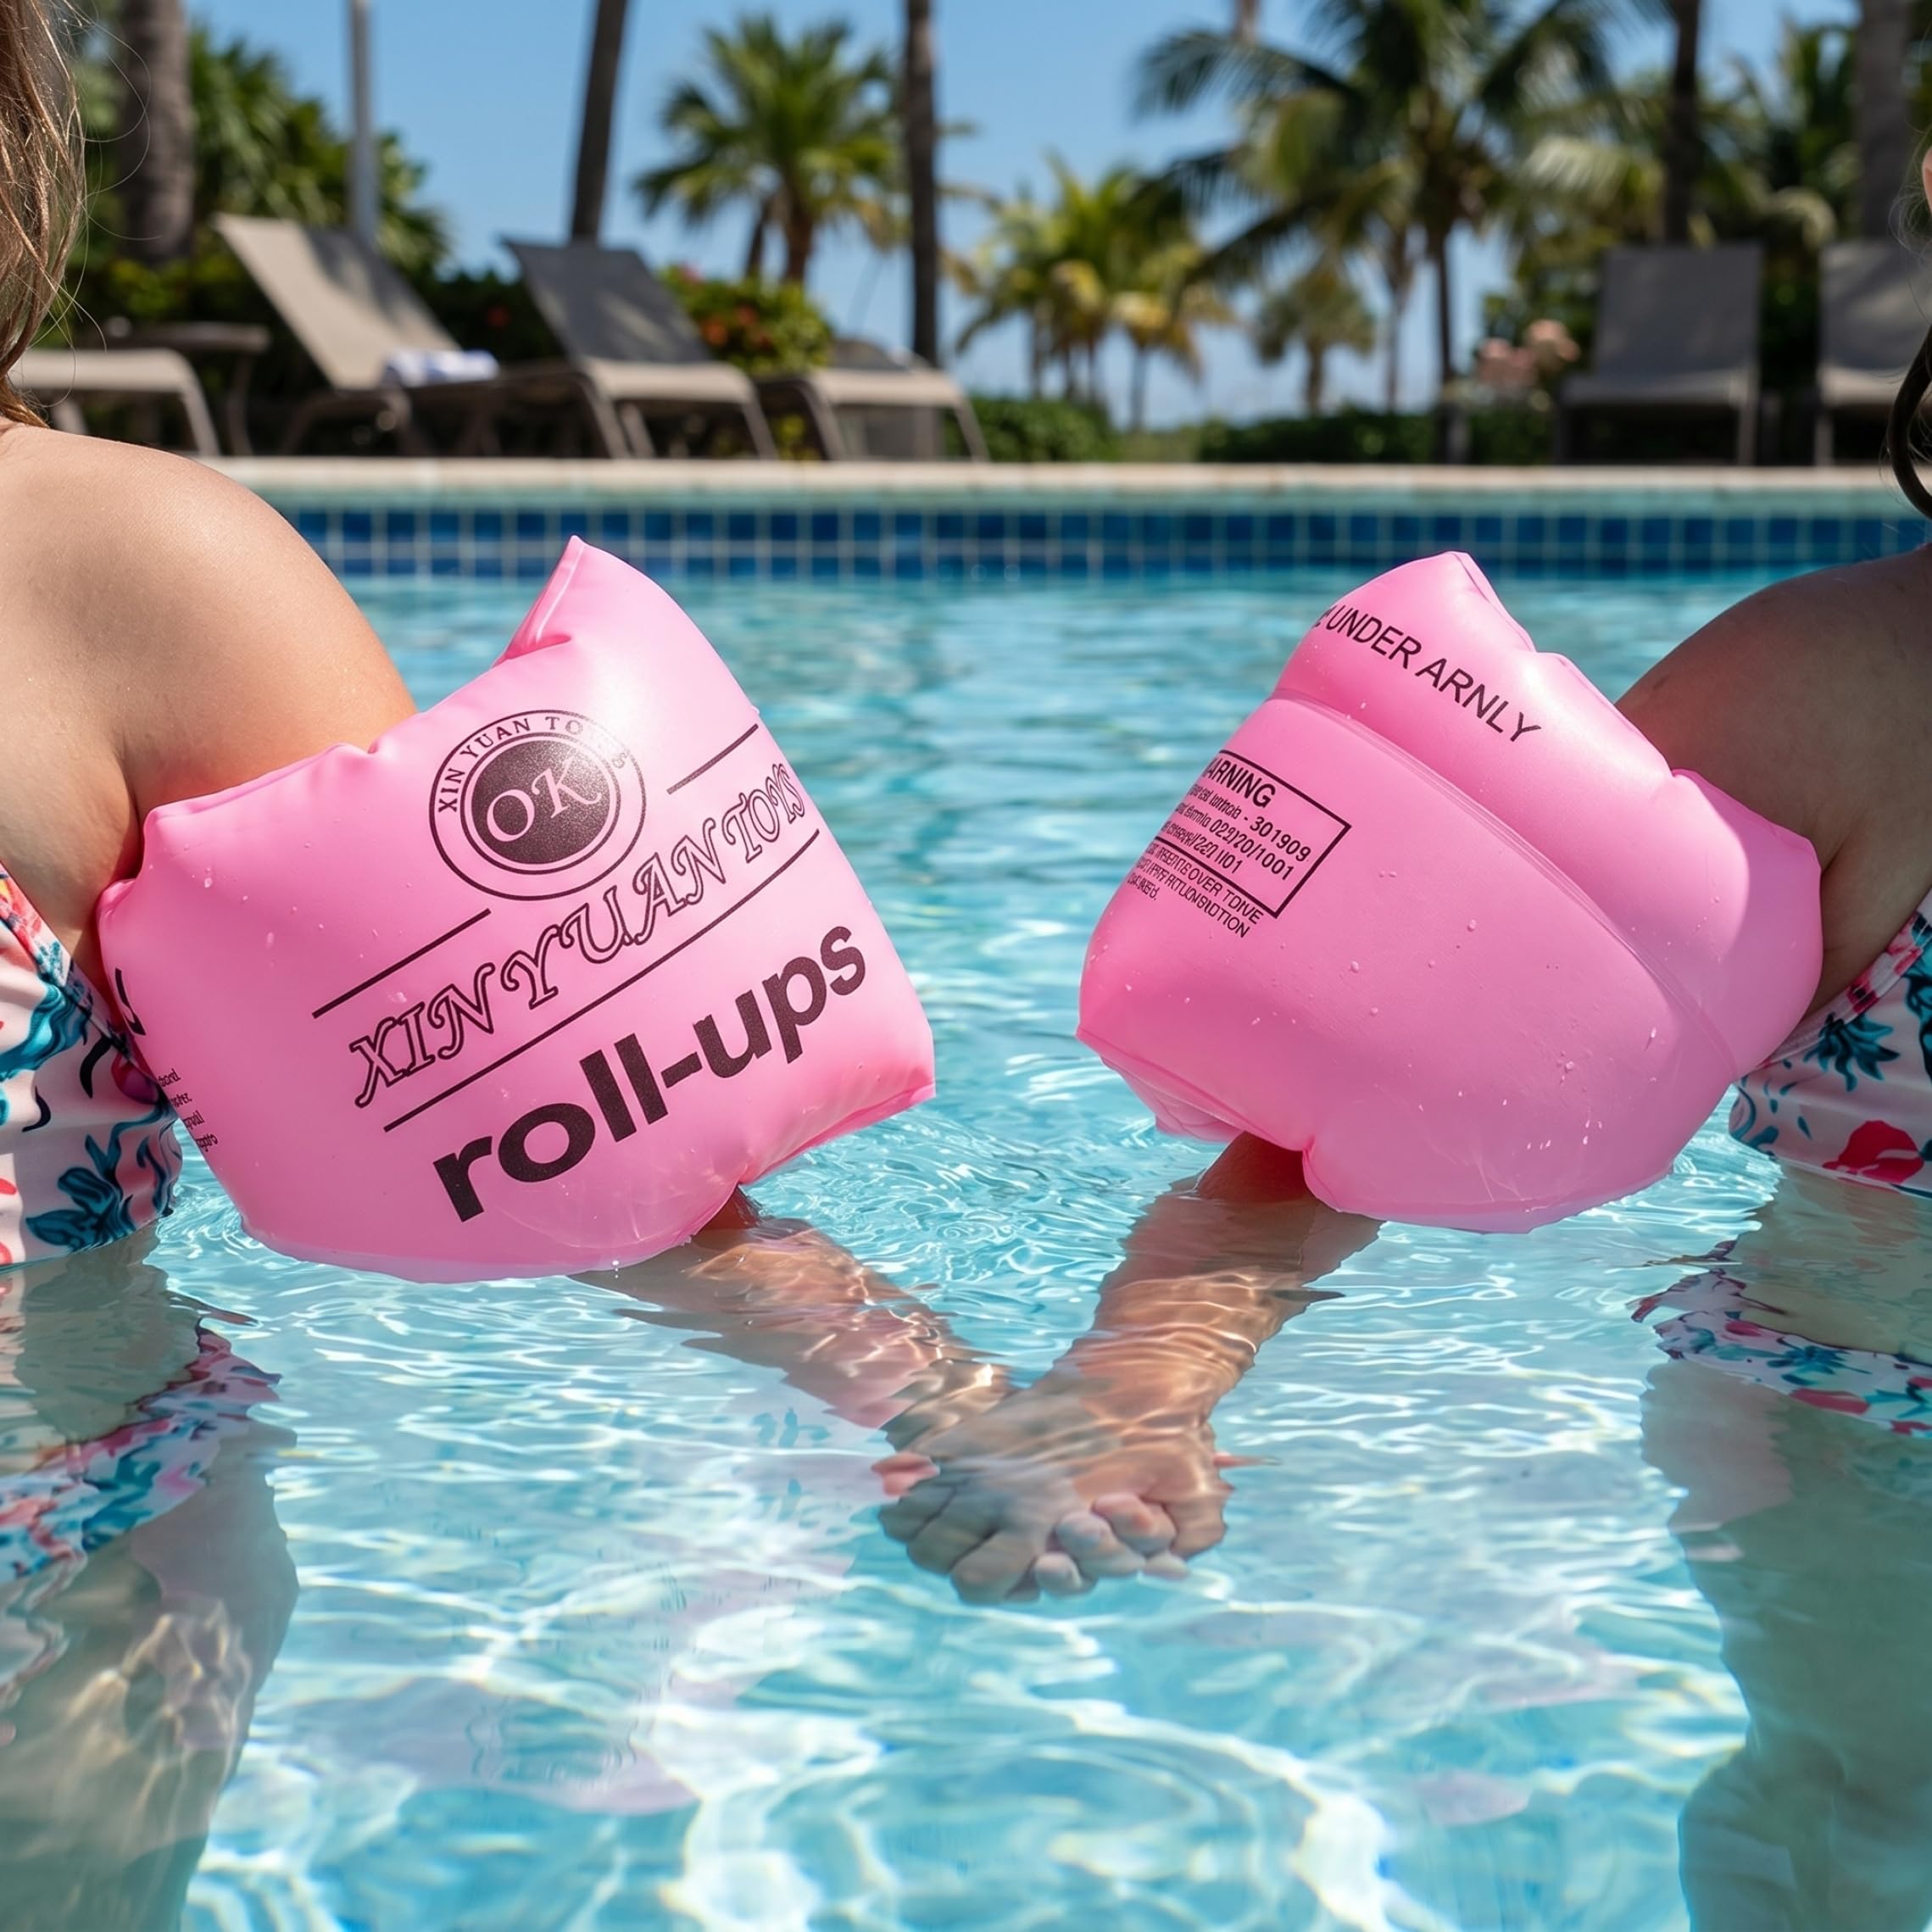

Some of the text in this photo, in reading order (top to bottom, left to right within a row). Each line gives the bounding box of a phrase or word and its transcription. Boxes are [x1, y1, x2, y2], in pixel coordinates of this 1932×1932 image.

[1326, 604, 1542, 743] UNDER ARNLY
[437, 715, 628, 813] XIN YUAN TOS
[486, 754, 603, 843] OK
[1201, 758, 1277, 810] ARNING
[722, 763, 806, 864] TOYS
[1249, 816, 1312, 863] 301909
[1187, 866, 1224, 897] OVER
[432, 926, 866, 1222] roll-ups
